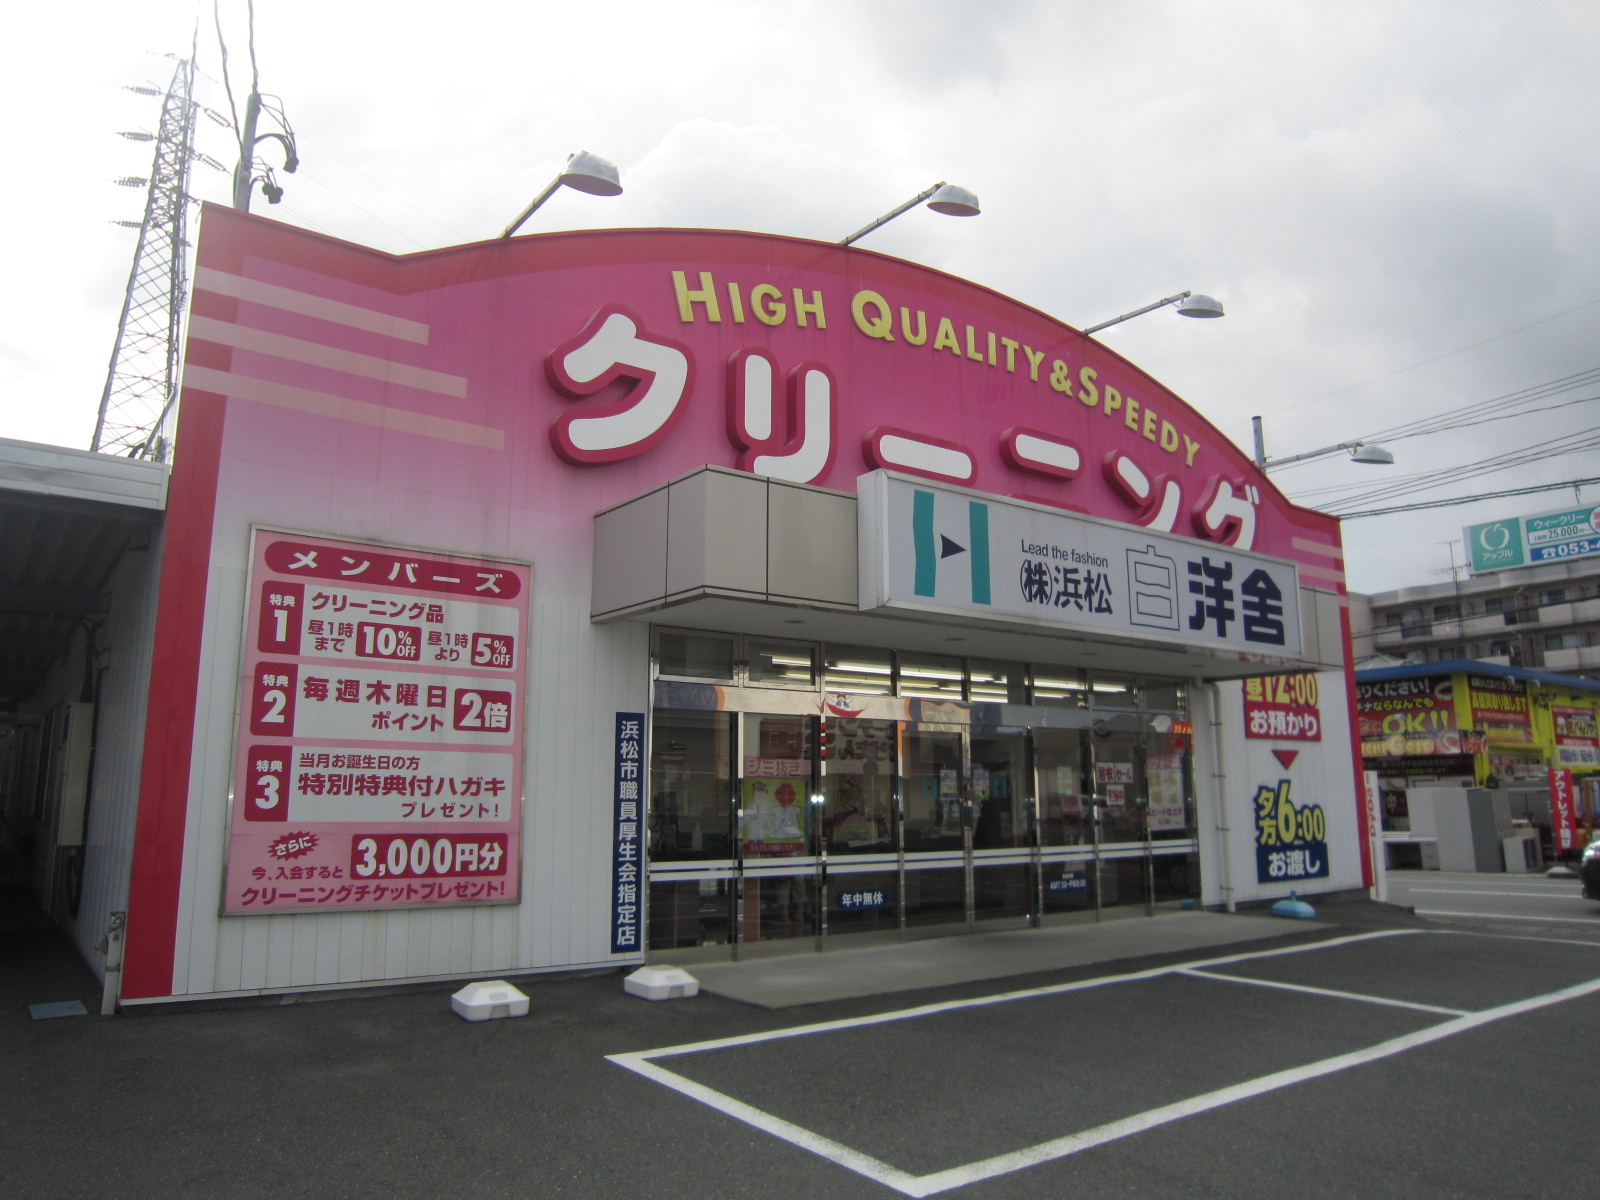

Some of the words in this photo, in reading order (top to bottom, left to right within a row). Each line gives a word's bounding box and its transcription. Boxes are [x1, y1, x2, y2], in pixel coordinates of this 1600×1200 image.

[671, 271, 827, 329] HIGH
[1534, 514, 1585, 529] ウィークリー
[1021, 539, 1048, 557] Lead
[1051, 545, 1068, 561] the
[1070, 547, 1109, 568] fashion
[1482, 549, 1513, 560] アップル
[288, 550, 503, 594] メンバーズ
[270, 593, 296, 607] 特典
[311, 592, 444, 624] クリーニング品
[274, 610, 287, 642] 1
[308, 620, 354, 639] 昼1時
[314, 637, 345, 652] まで
[427, 631, 468, 648] 昼1時
[435, 646, 459, 662] より
[262, 674, 289, 688] 特典
[303, 676, 447, 708] 毎週木曜日
[261, 690, 286, 723] 2
[459, 693, 508, 728] 2倍
[371, 711, 444, 732] ポイント
[1249, 709, 1318, 737] お預かり
[1382, 710, 1449, 734] OK!!
[256, 760, 283, 772] 特典
[299, 753, 420, 771] 当月お誕生日の方
[747, 757, 802, 778] シミ抜き
[255, 776, 279, 810] 3
[298, 774, 505, 797] 特別特典付ハガキ
[401, 802, 499, 819] プレゼント!
[1277, 783, 1324, 844] 6:00
[616, 720, 640, 946] 浜松市職員厚生会指定店
[275, 836, 312, 857] さらに
[355, 838, 503, 877] 3,000円分
[252, 865, 343, 881] 今、入会すると
[1268, 849, 1320, 877] お渡し
[241, 881, 505, 906] クリーニングチケットプレゼント!
[841, 891, 884, 907] 年中無休
